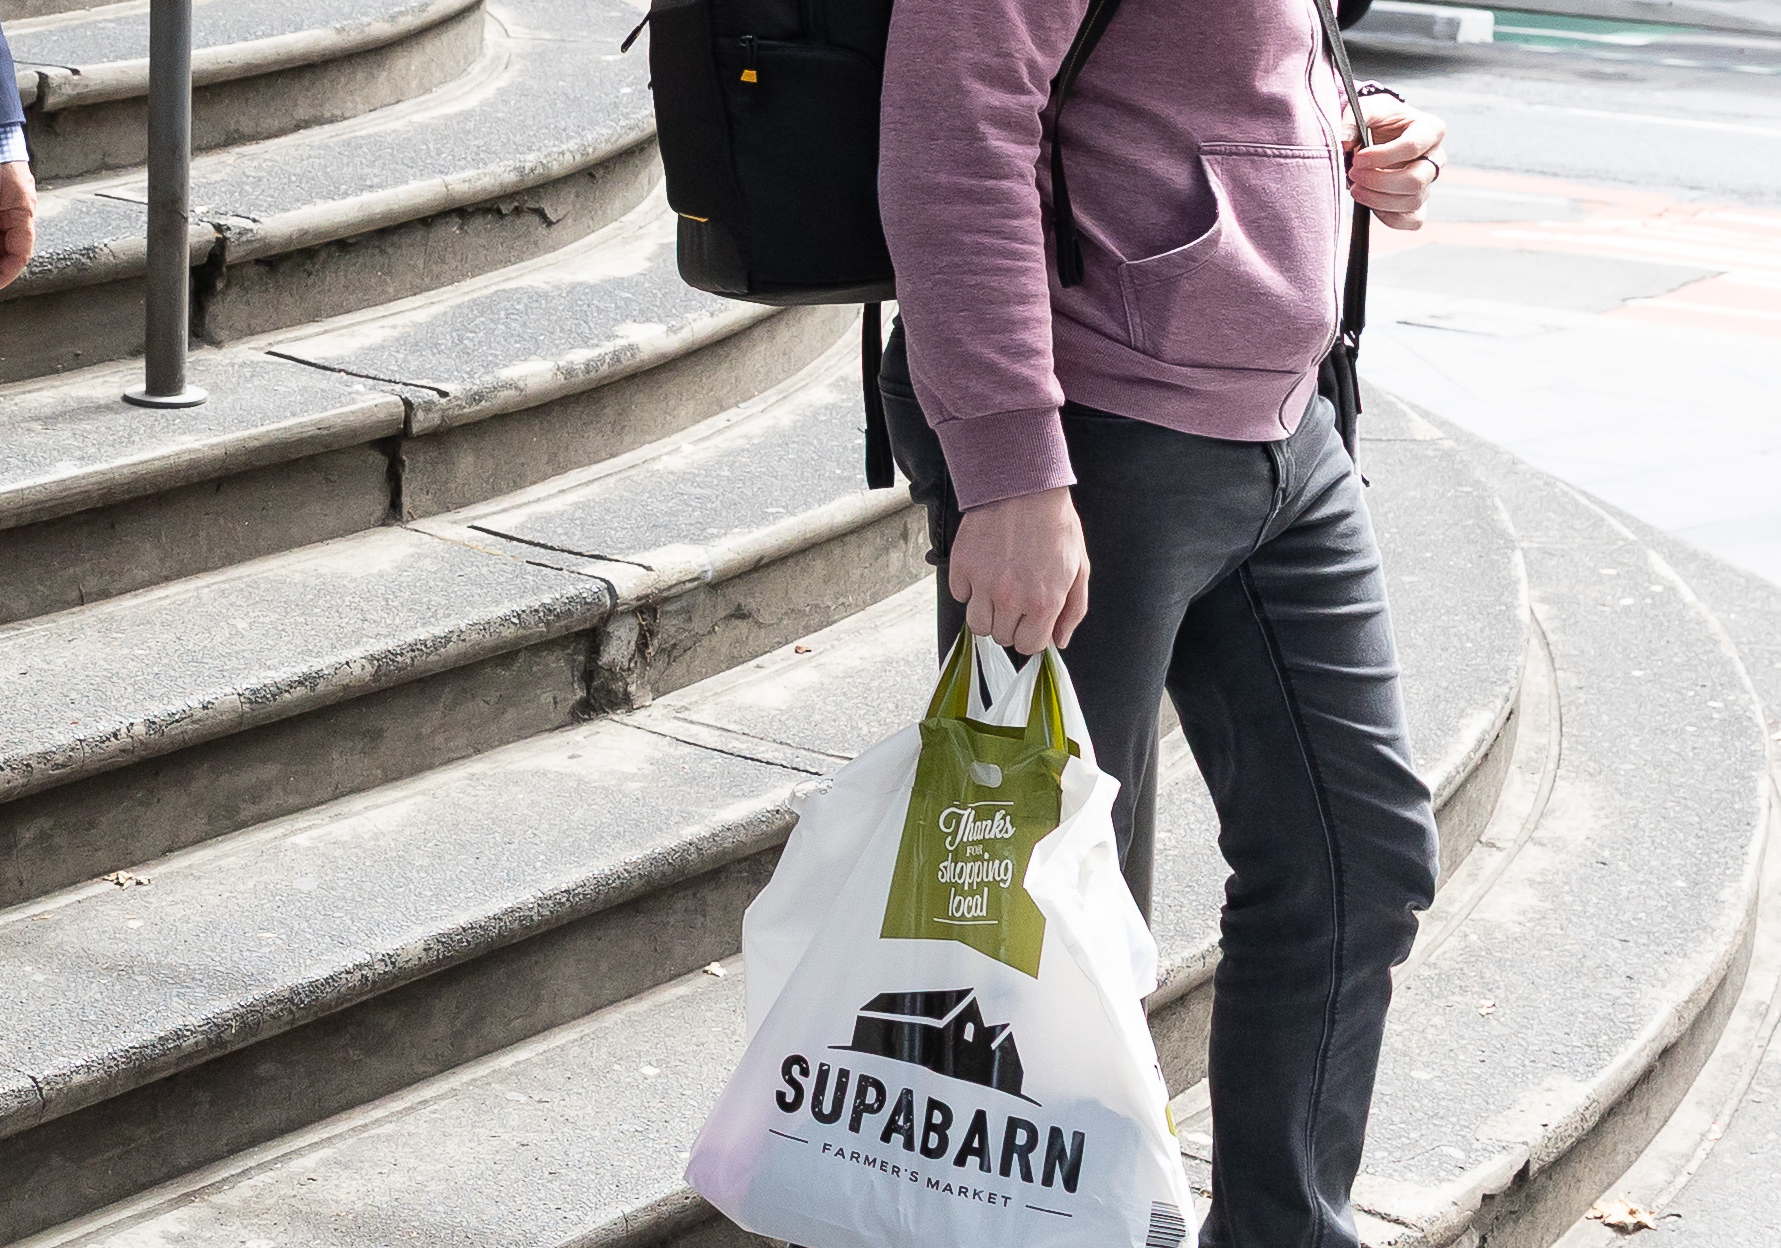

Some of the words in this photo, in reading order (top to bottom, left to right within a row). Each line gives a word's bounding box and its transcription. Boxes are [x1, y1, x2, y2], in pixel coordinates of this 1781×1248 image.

[939, 807, 1016, 851] Thanks
[966, 844, 984, 856] FOR
[938, 852, 1014, 890] shopping
[948, 887, 988, 918] local
[775, 1054, 1086, 1194] SUPABARN
[821, 1142, 920, 1183] FARMER'S
[926, 1176, 1012, 1208] MARKET
